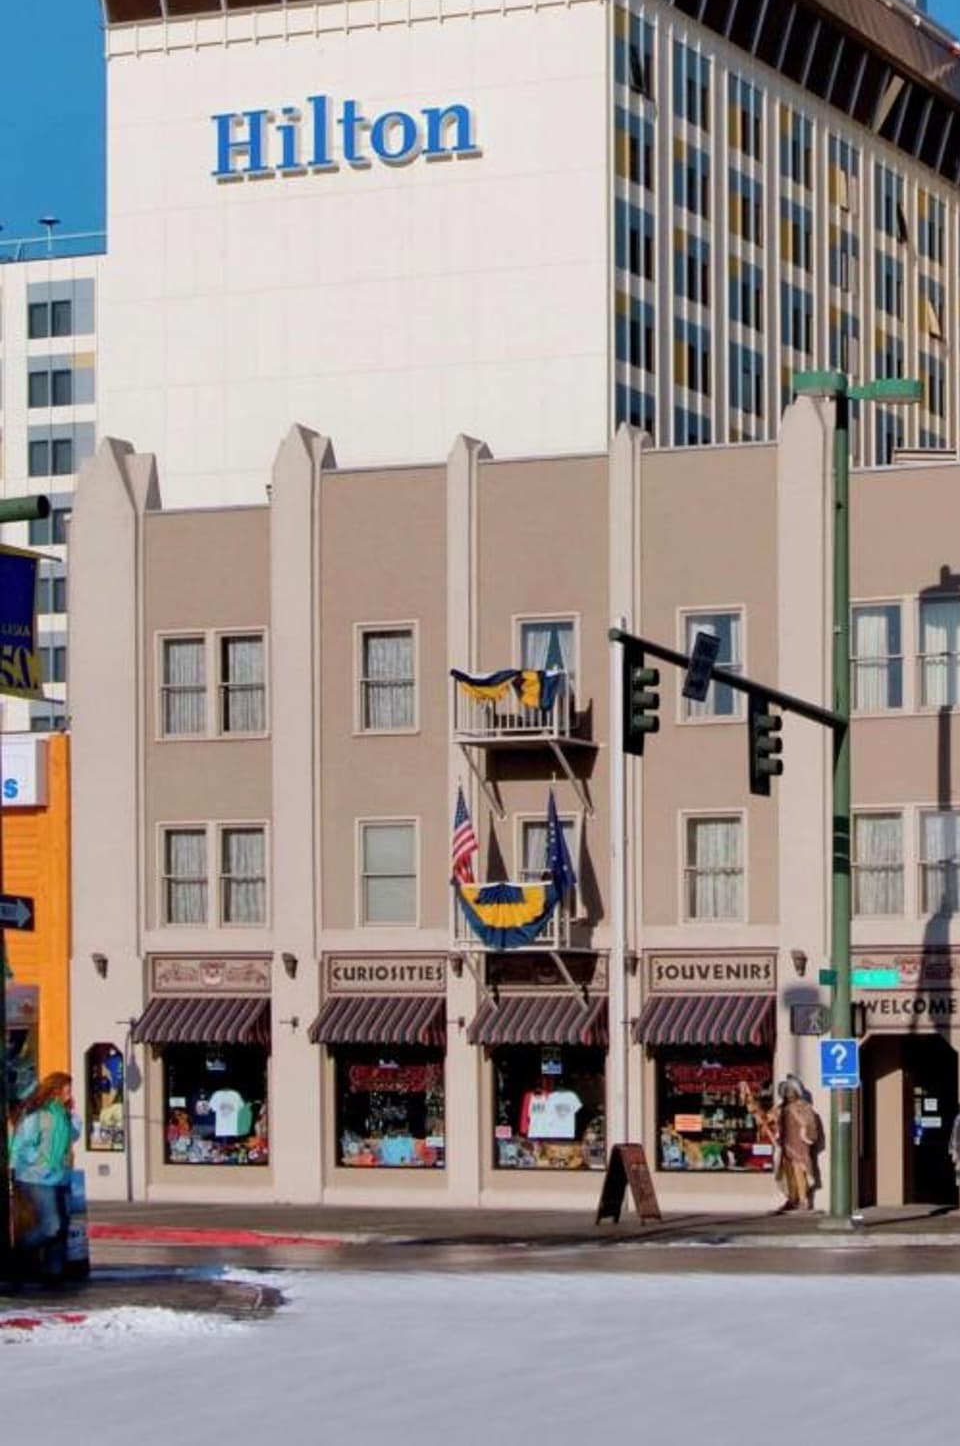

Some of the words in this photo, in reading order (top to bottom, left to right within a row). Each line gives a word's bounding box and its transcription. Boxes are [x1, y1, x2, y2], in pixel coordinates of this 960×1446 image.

[210, 94, 480, 181] Hilton
[332, 965, 443, 982] CURIOSITIES
[656, 963, 771, 981] SOUVENIRS
[861, 998, 958, 1015] WELCOME
